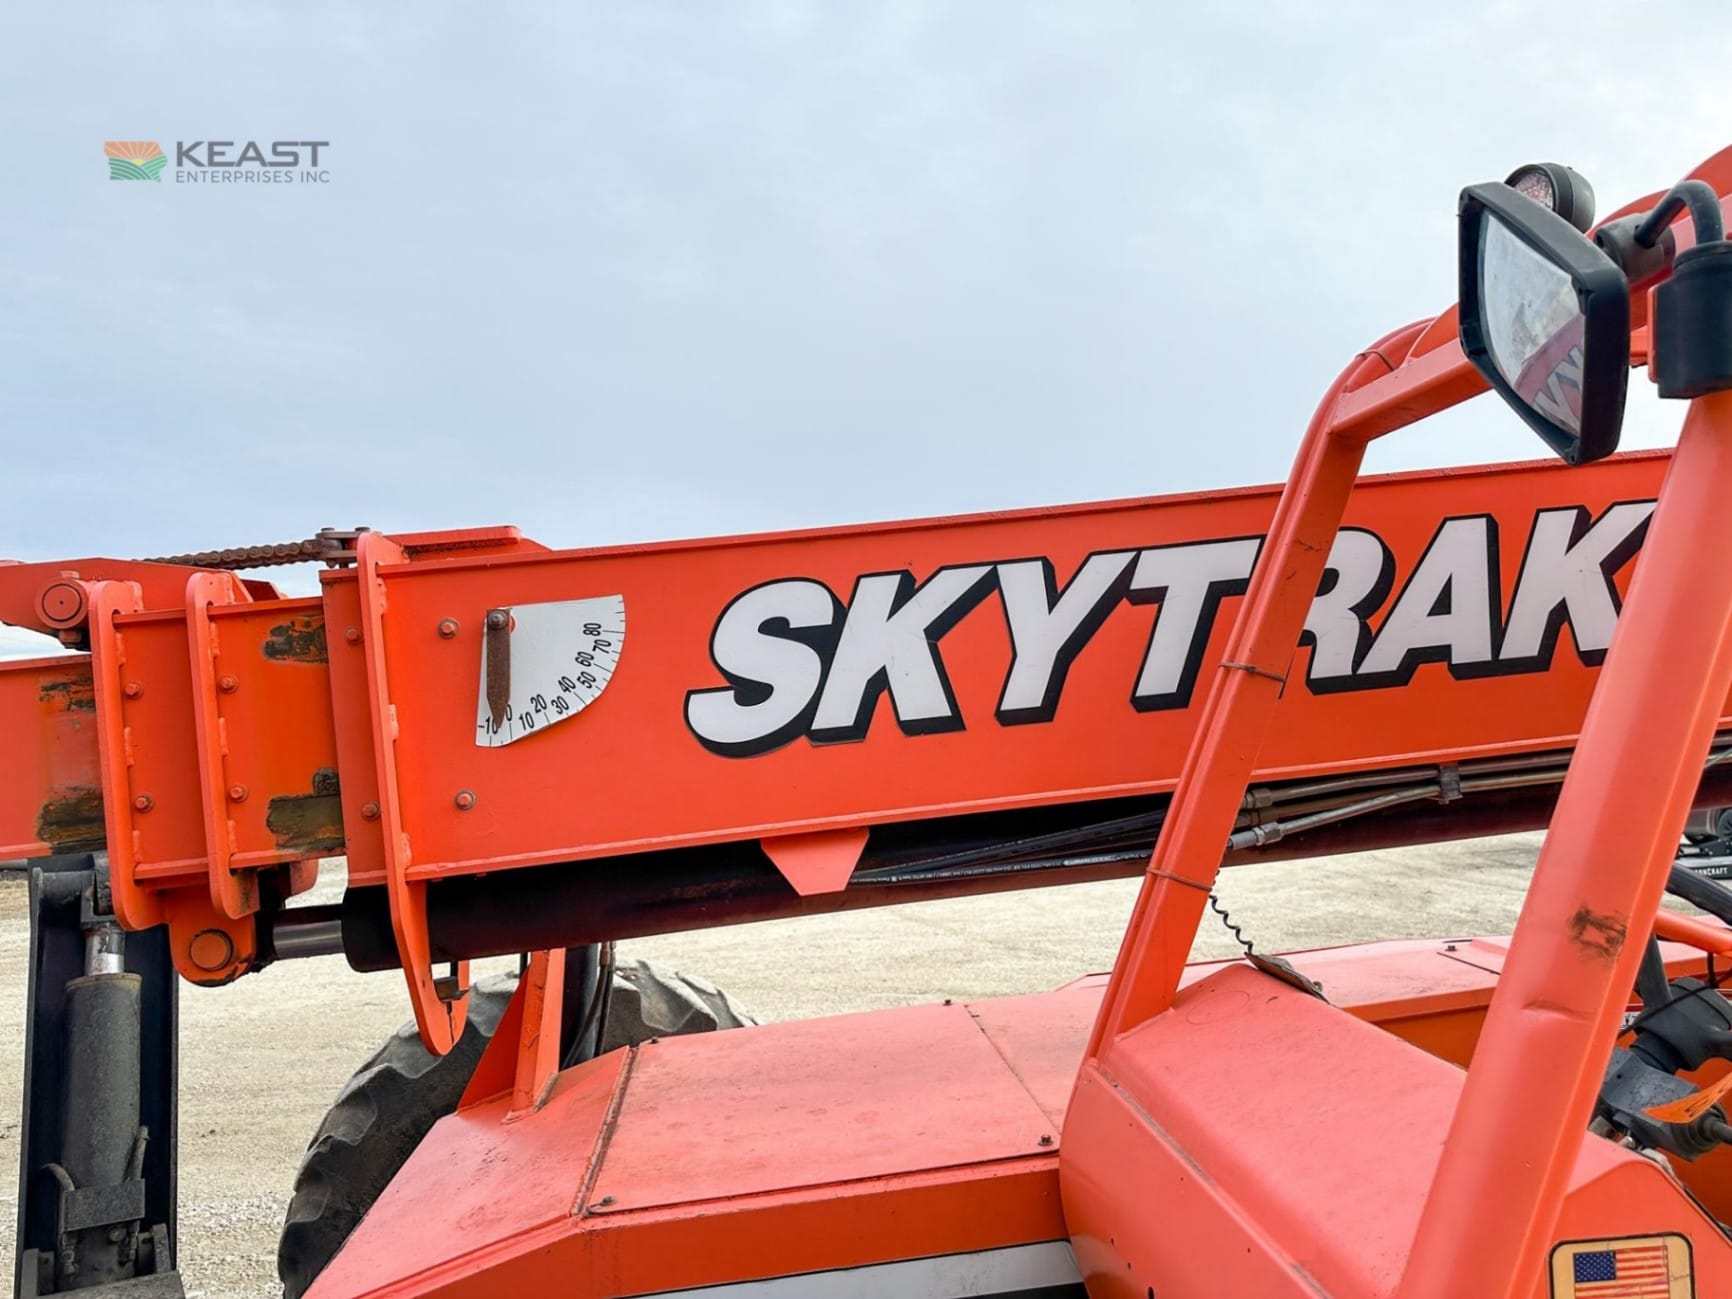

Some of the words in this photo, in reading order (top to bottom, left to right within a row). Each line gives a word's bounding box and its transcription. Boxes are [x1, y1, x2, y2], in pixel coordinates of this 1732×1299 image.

[583, 622, 602, 636] 80
[684, 498, 1658, 759] SKYTRAK
[592, 639, 612, 654] 70
[575, 651, 594, 667] 60
[558, 676, 576, 693] 40
[577, 671, 597, 689] 50
[530, 694, 547, 714] 20
[551, 696, 569, 715] 30
[519, 711, 535, 730] 10
